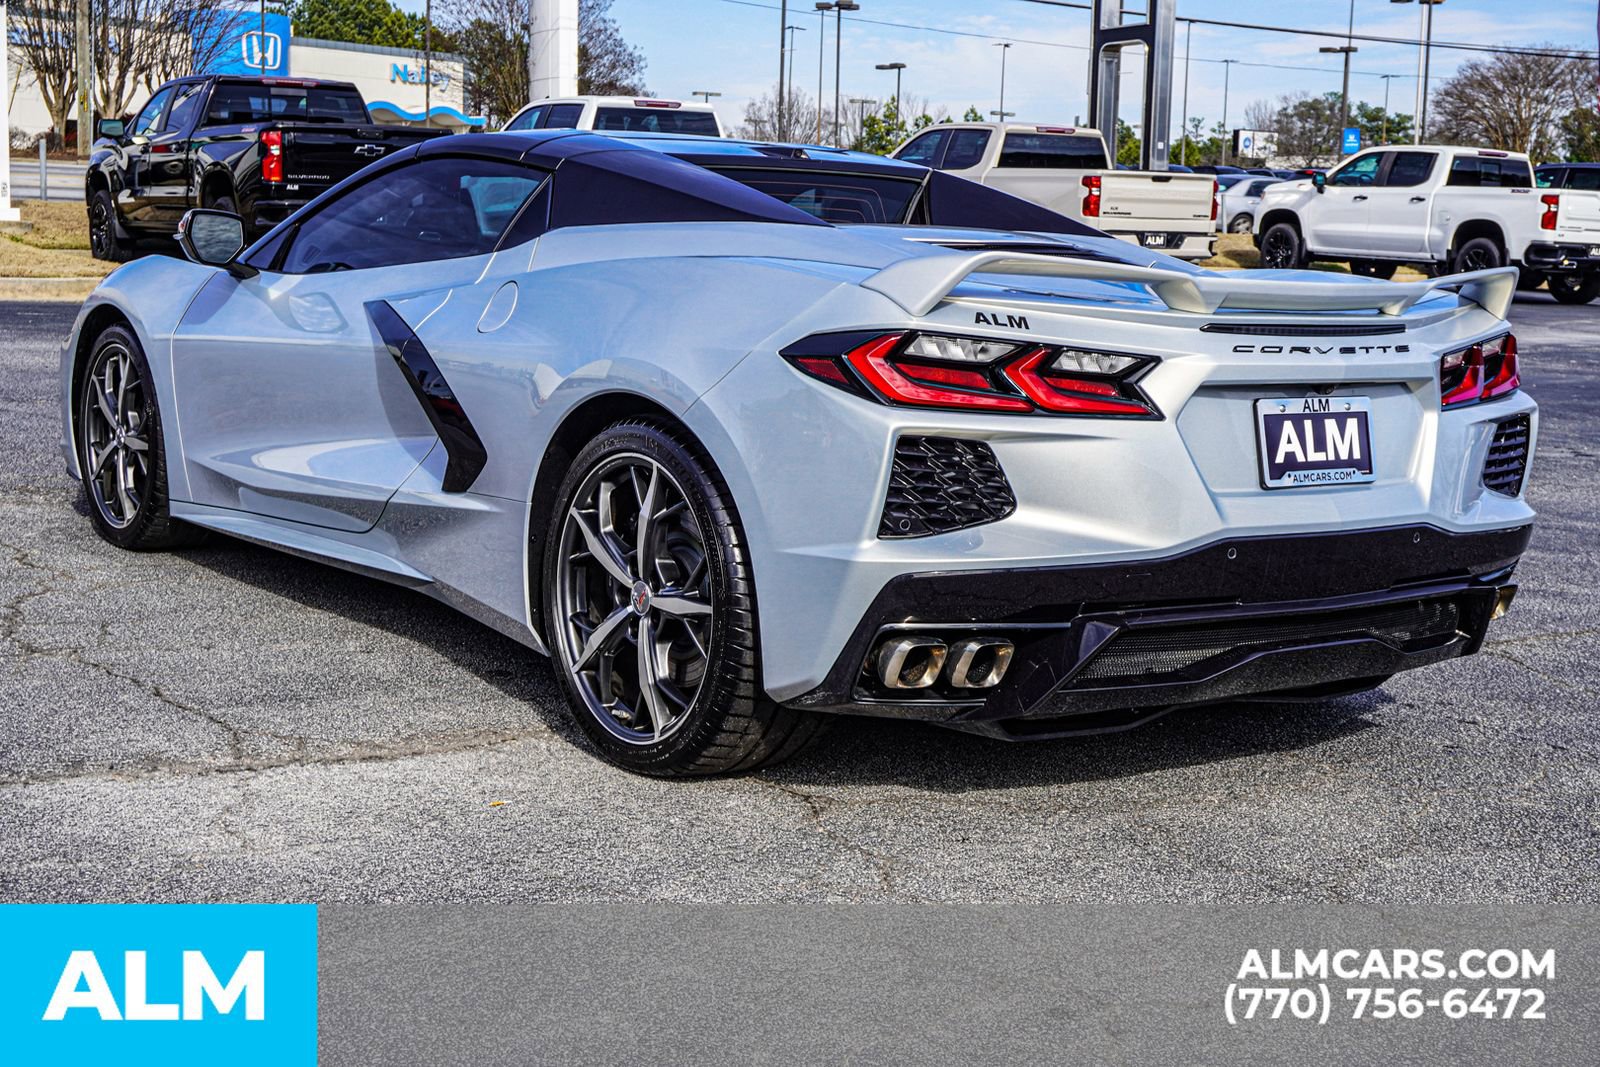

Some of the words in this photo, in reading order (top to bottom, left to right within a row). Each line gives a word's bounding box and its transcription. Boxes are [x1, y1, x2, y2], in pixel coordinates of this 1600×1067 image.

[390, 63, 449, 92] Naley
[1145, 234, 1165, 245] ALM
[1590, 247, 1600, 256] AL
[975, 312, 1030, 330] ALM
[1232, 344, 1411, 355] CORVETTE
[1302, 398, 1331, 413] ALM
[1274, 417, 1362, 464] ALM
[1292, 471, 1353, 483] ALMCARS.COM
